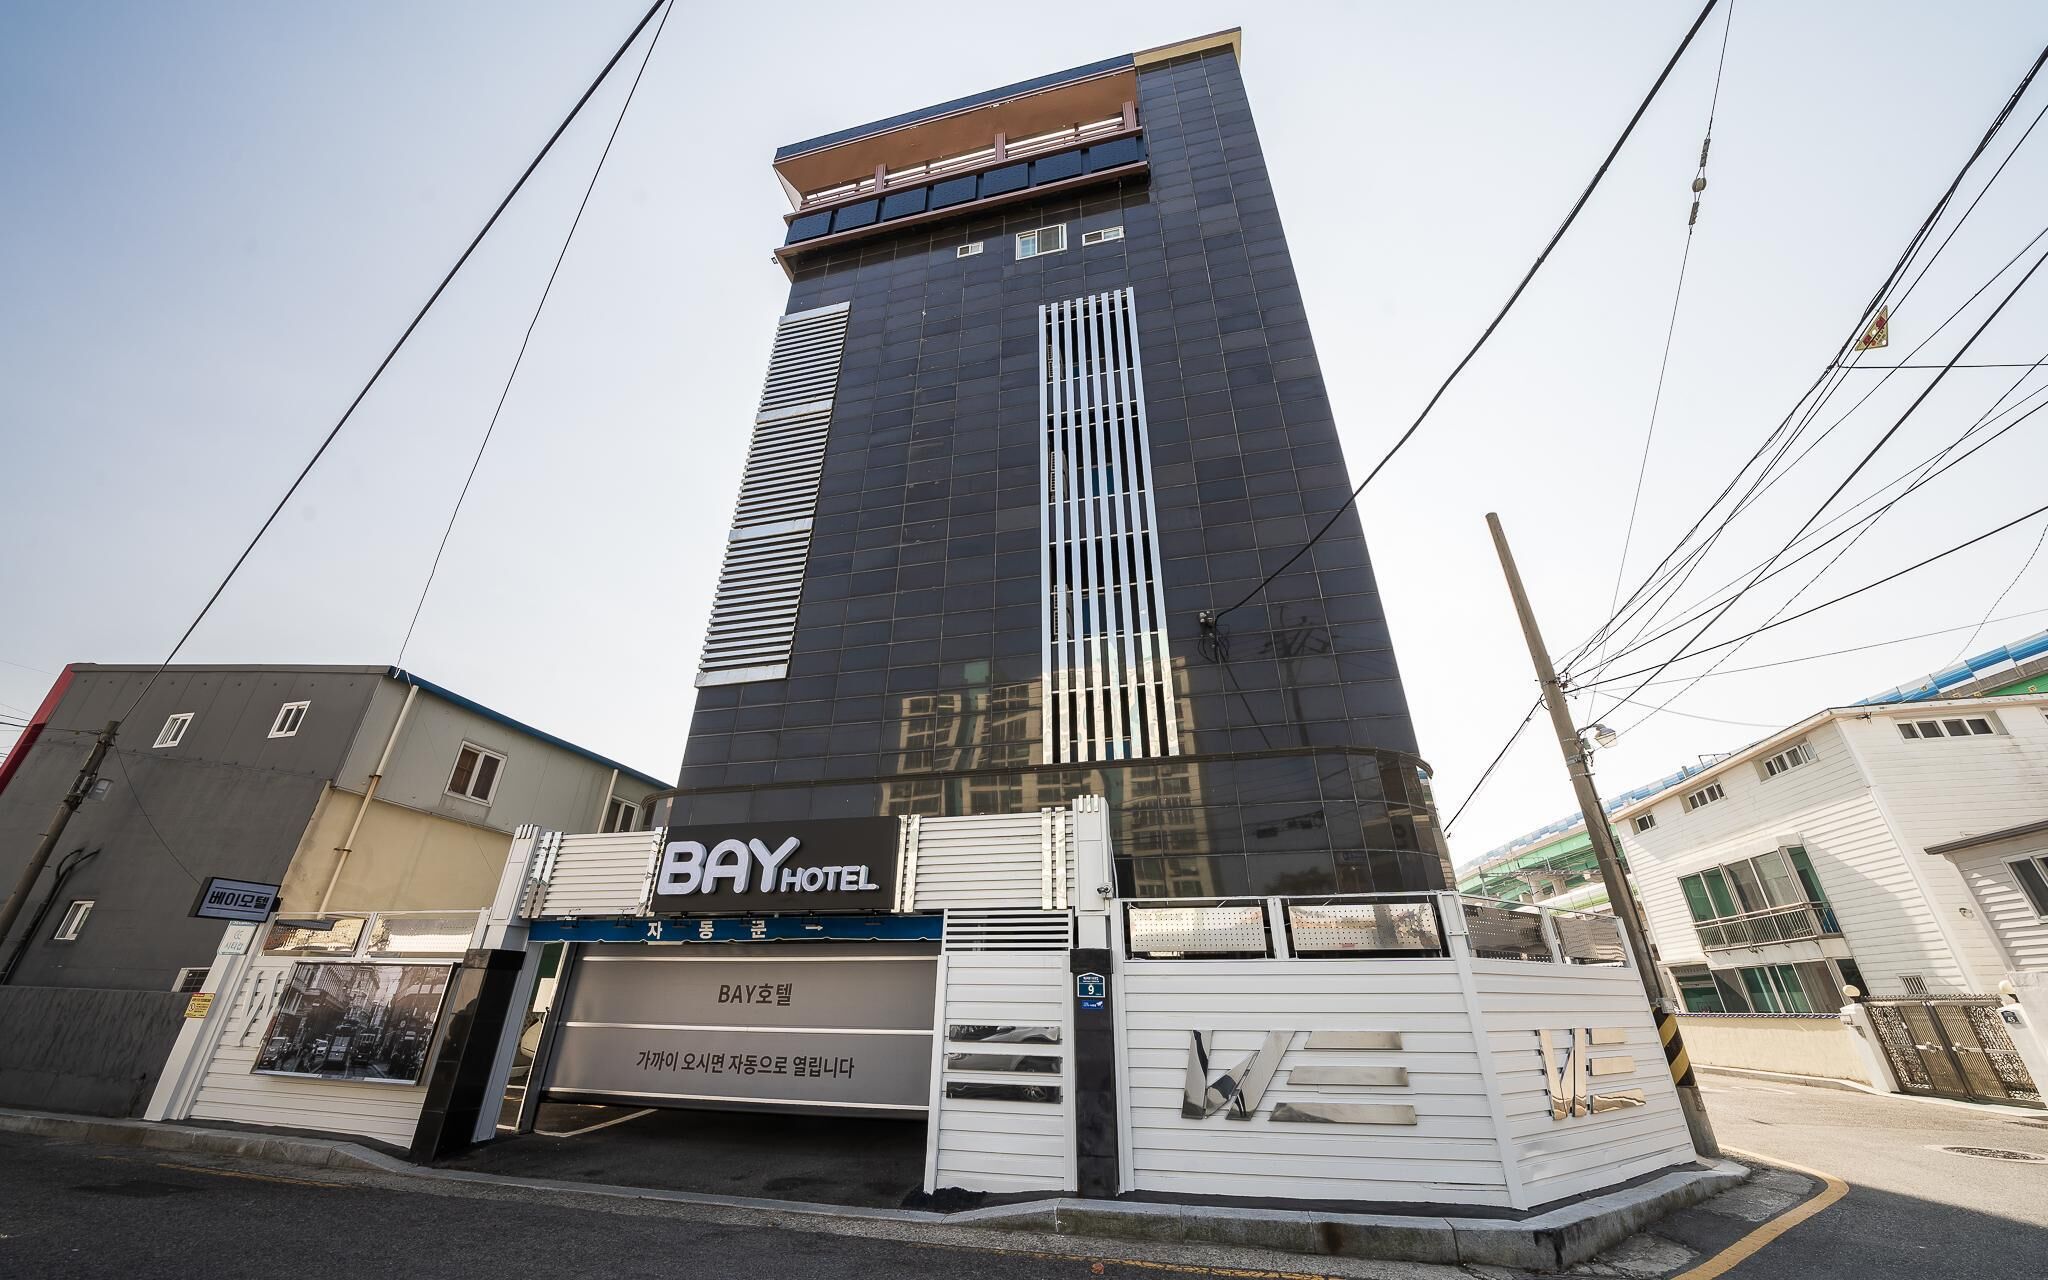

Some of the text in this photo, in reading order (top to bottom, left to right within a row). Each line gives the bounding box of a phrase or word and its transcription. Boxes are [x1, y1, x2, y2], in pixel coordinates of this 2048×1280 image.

[656, 836, 880, 896] BAY HOTEL
[208, 890, 270, 910] 베이모텔
[717, 983, 793, 1007] BAY호텔
[1087, 984, 1095, 995] 9
[636, 1050, 855, 1079] 가까이 오시면 자동으로 열립니다
